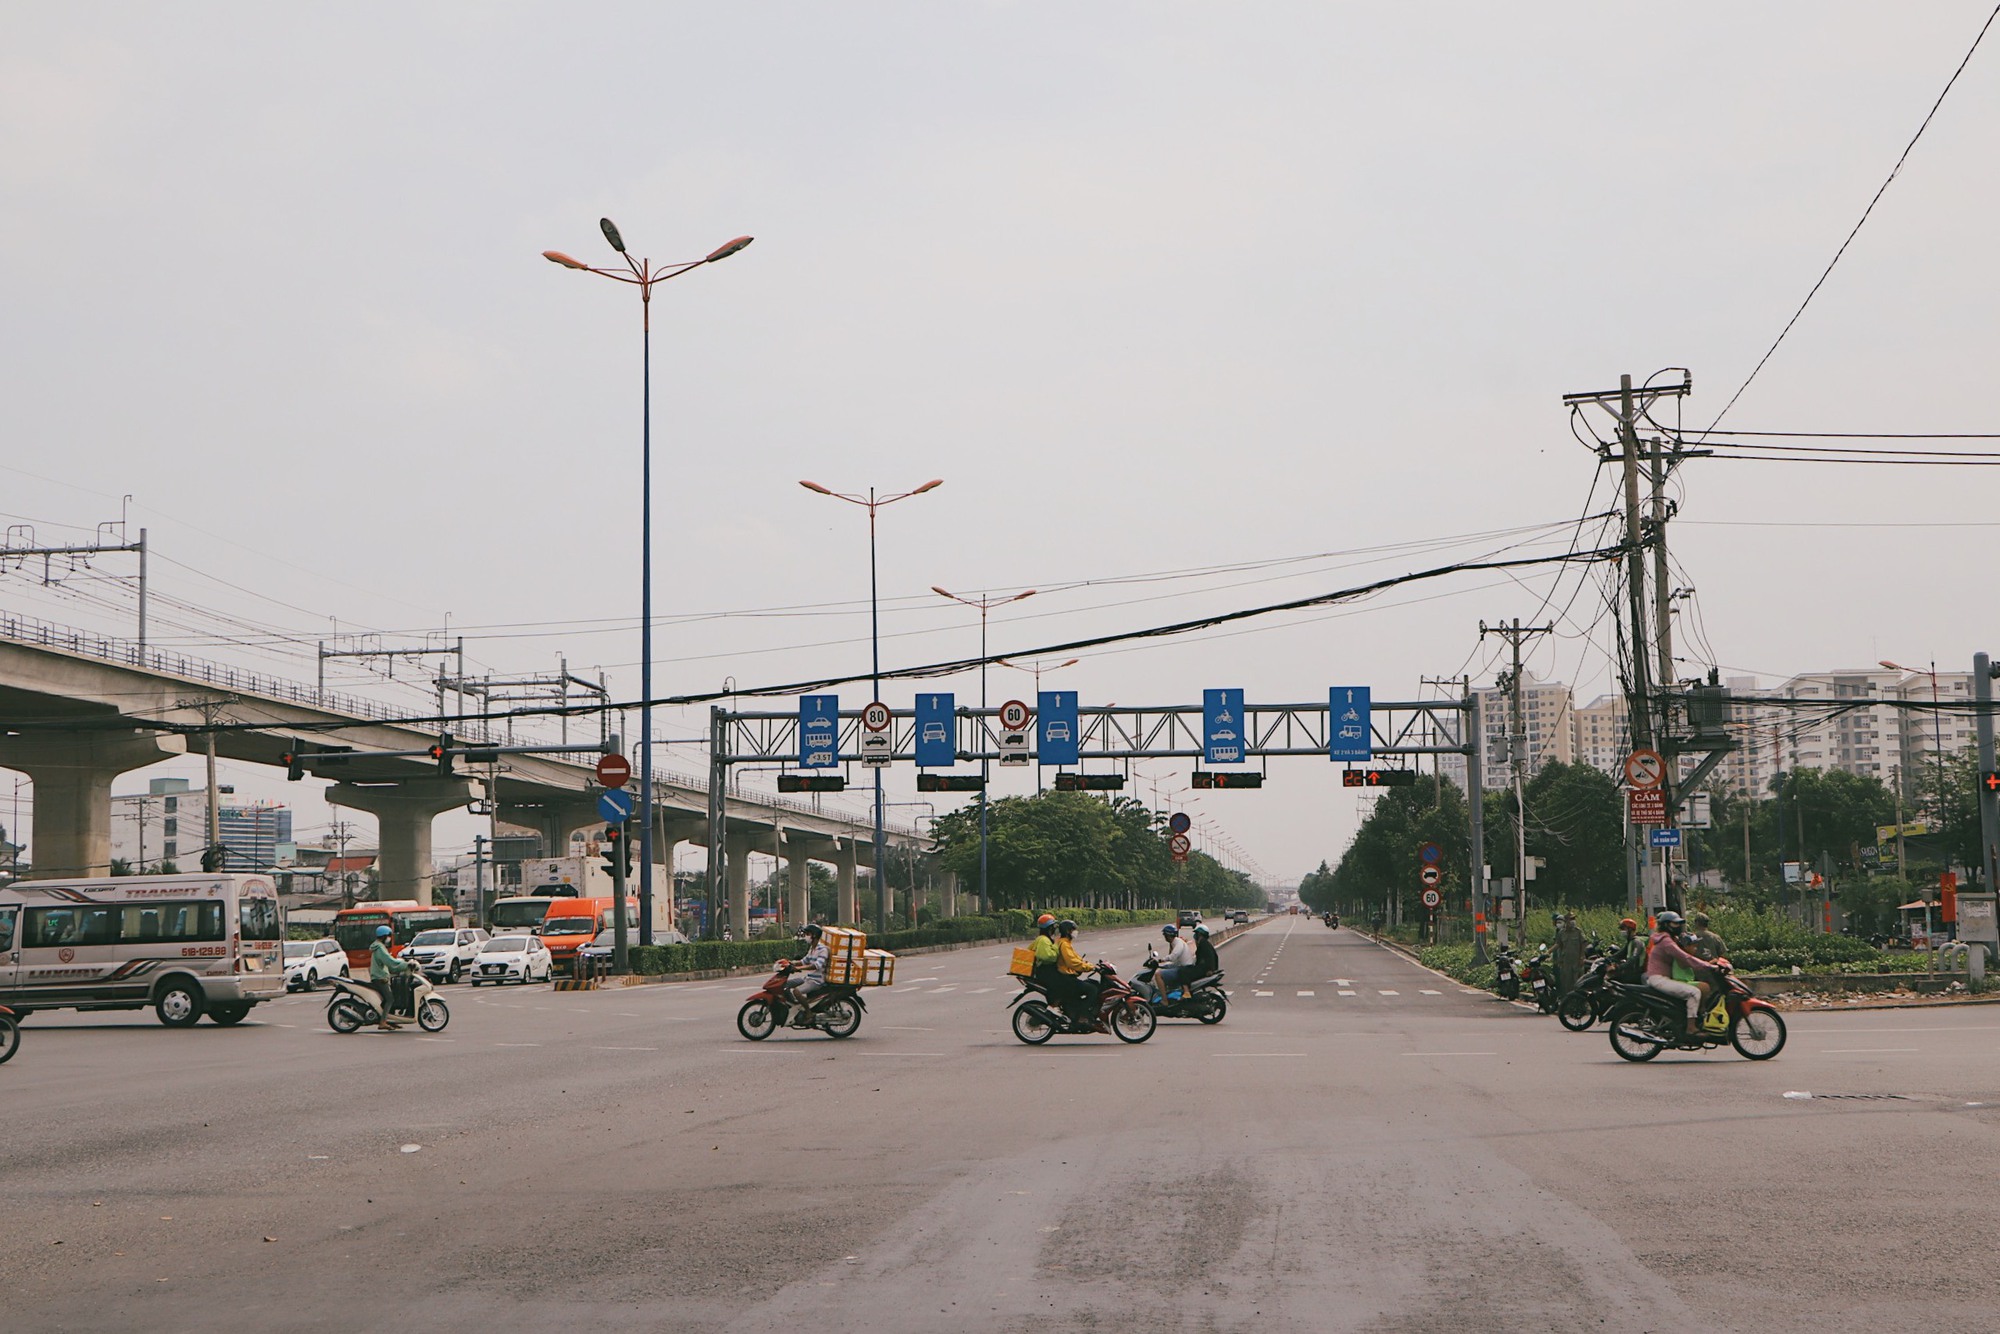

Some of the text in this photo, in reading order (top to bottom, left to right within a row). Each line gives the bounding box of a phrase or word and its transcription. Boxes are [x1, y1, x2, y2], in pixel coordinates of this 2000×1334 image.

[869, 710, 884, 723] 80
[1007, 708, 1021, 721] 60
[1635, 791, 1660, 801] CẤM
[125, 887, 201, 899] TRANSIT
[1426, 894, 1436, 903] 60
